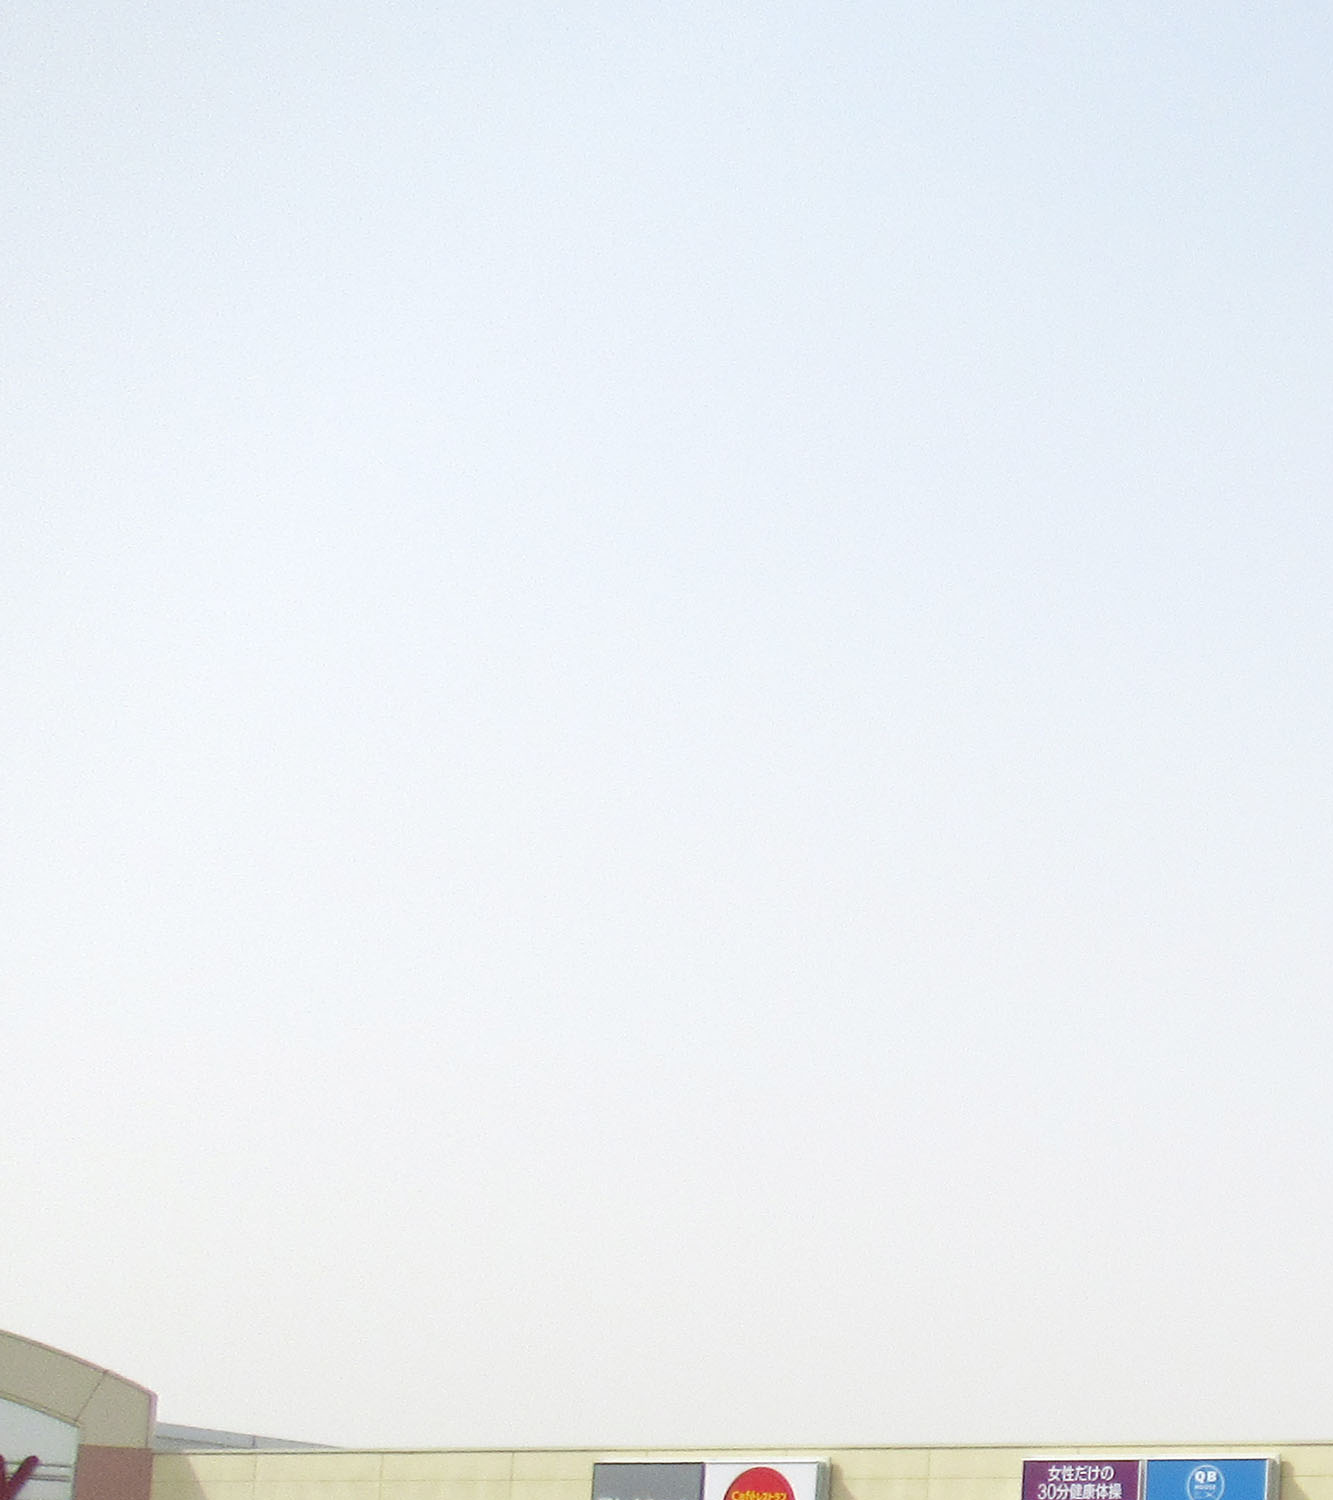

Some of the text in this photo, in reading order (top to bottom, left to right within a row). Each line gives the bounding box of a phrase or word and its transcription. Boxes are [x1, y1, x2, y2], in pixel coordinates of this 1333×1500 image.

[1048, 1465, 1114, 1482] 女性だけの
[1195, 1470, 1217, 1483] QB
[1037, 1483, 1122, 1500] 30分健康体操
